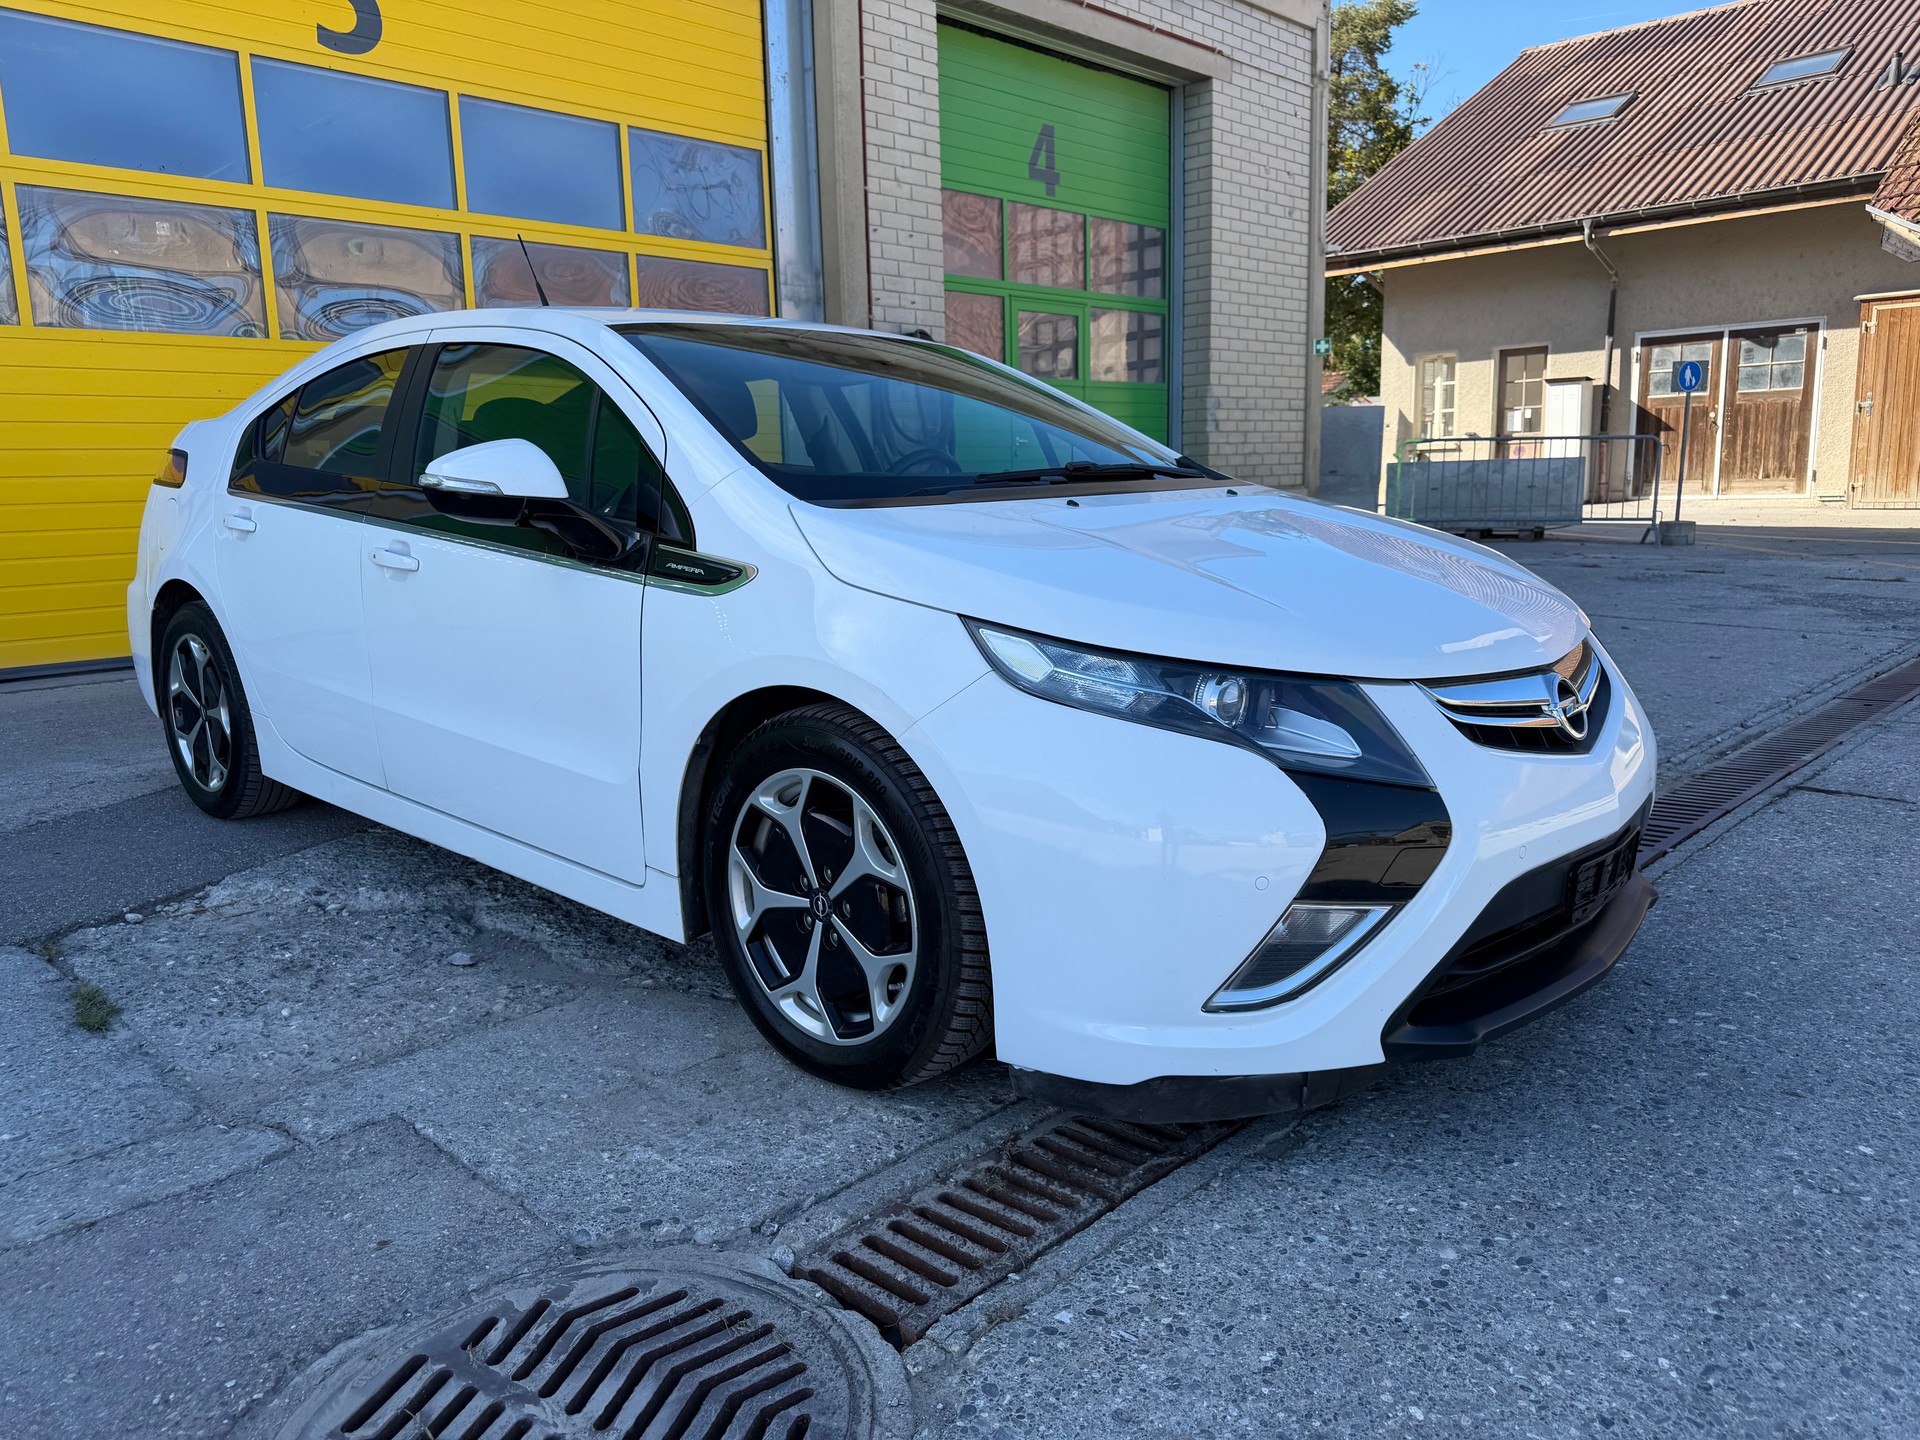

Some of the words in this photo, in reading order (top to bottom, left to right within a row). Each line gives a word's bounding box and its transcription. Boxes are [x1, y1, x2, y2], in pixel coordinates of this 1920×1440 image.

[1028, 124, 1060, 197] 4
[665, 562, 705, 576] AMPERA
[865, 769, 887, 796] PRO
